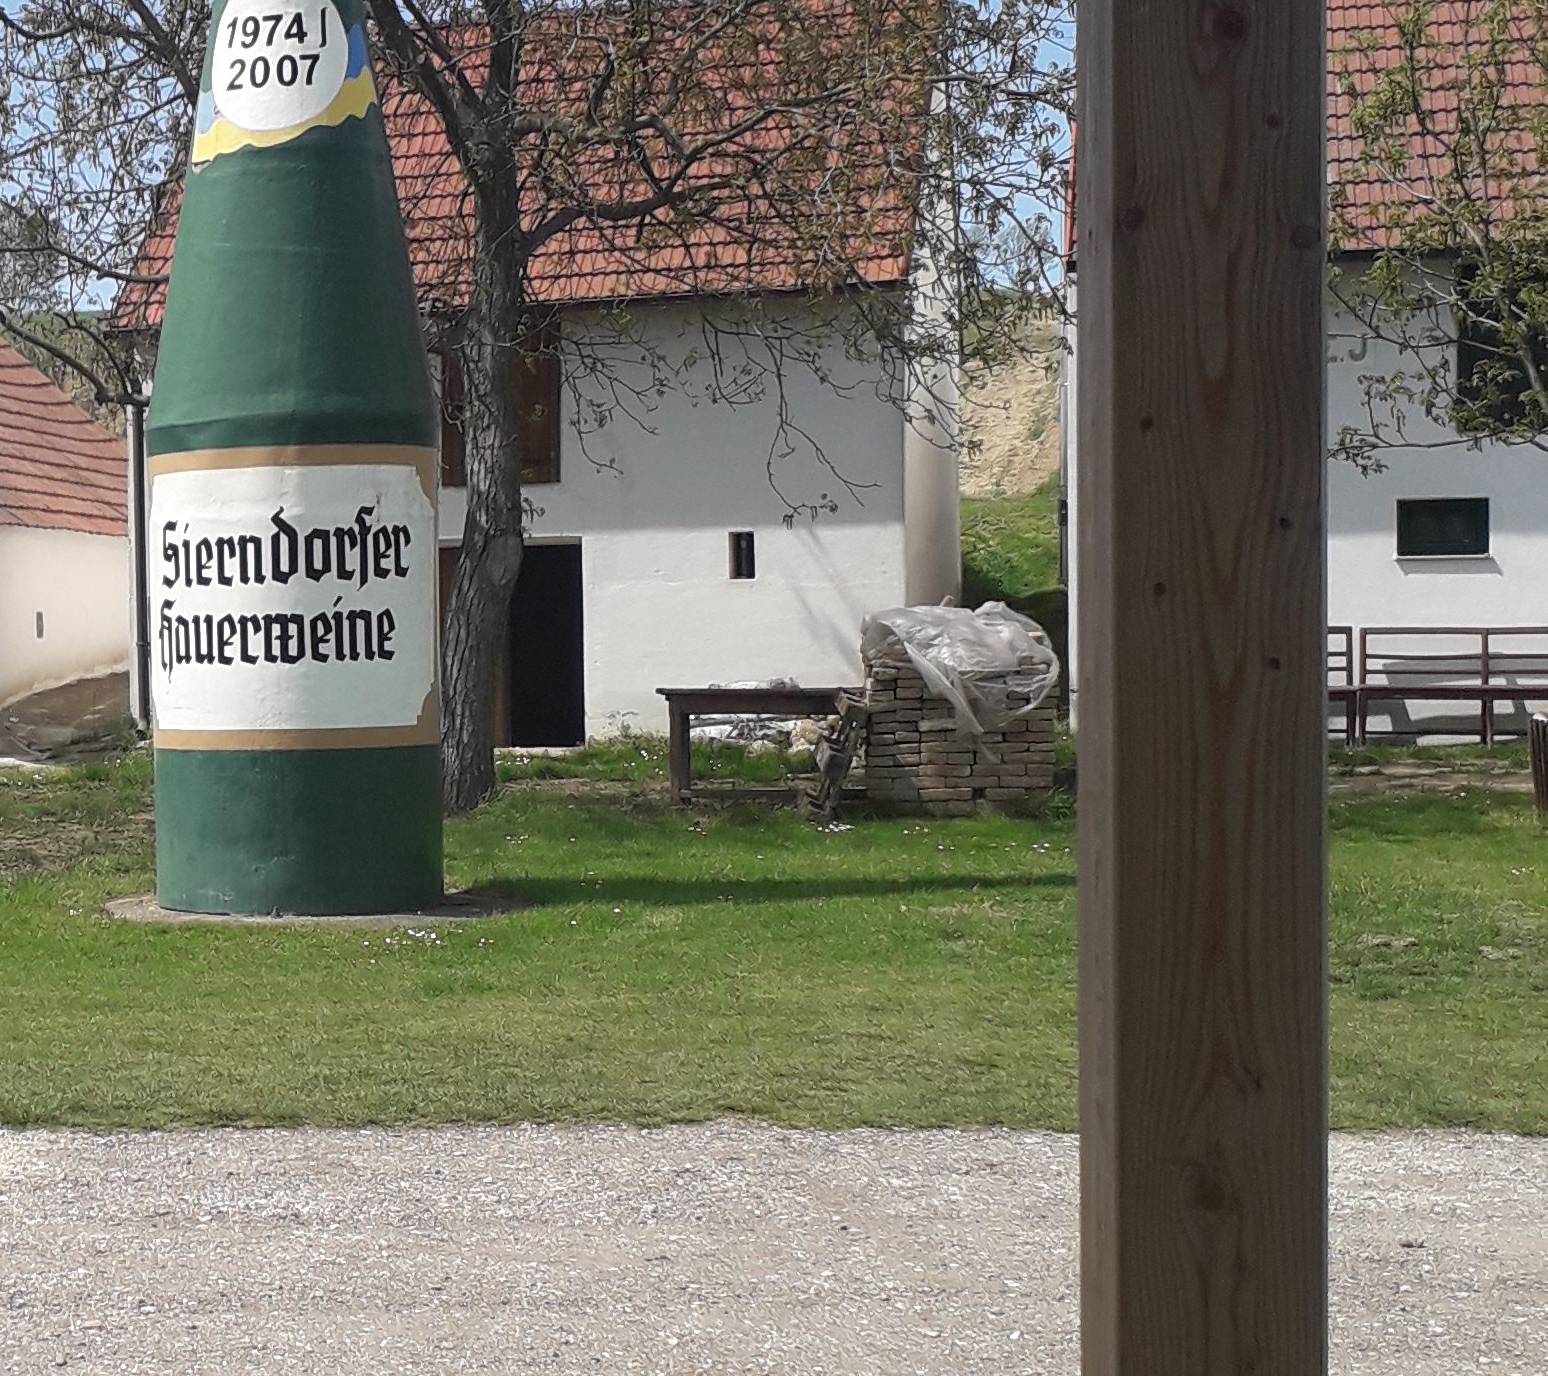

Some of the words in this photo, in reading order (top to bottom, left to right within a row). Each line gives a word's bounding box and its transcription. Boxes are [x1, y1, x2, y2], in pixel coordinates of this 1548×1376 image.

[227, 12, 307, 49] 1974
[226, 53, 320, 91] 2007
[162, 505, 412, 591] Sierndorfer
[159, 595, 396, 680] Hauerweine
